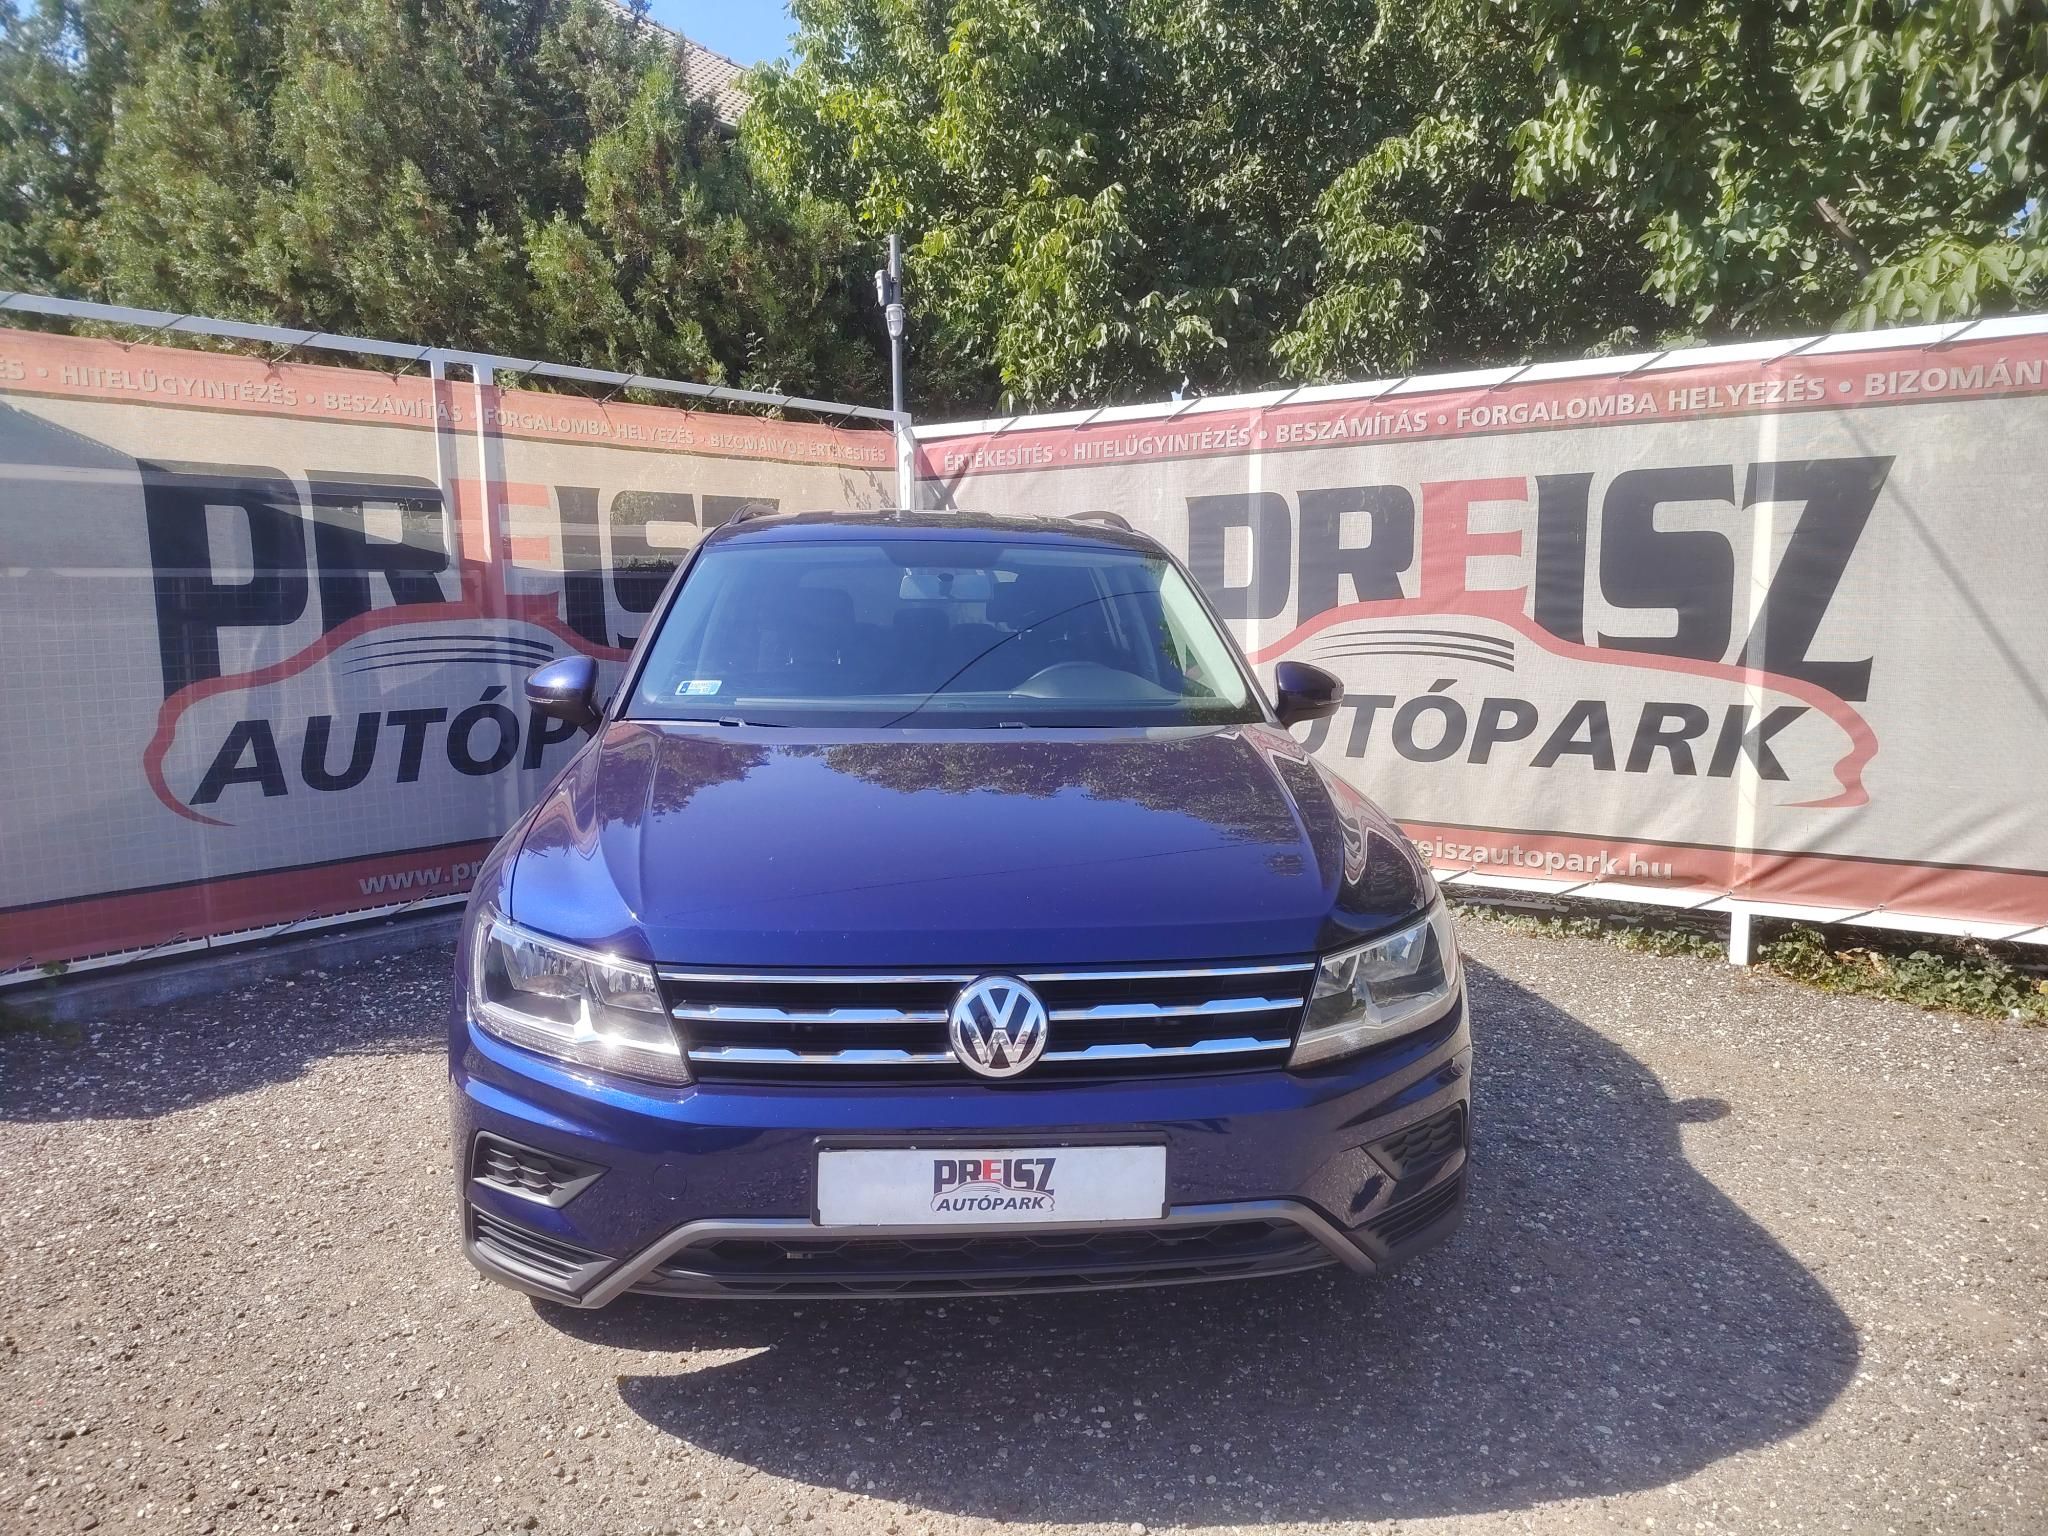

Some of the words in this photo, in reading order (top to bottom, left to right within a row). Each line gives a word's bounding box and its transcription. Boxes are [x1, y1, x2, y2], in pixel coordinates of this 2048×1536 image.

[62, 364, 299, 407] HITELÜGYINTÉZÉS
[323, 391, 464, 422] BESZÁMÍTÁS
[484, 408, 613, 437] FORGALOMBA
[616, 420, 696, 445] HELYEZÉS
[944, 445, 1053, 472] ÉRTÉKESÍTÉS
[1074, 425, 1252, 461] HITELÜGYINTÉZÉS
[1275, 408, 1428, 444] BESZÁMÍTÁS
[1456, 390, 1659, 428] FORGALOMBA
[1667, 373, 1826, 412] HELYEZÉS
[1864, 357, 2048, 397] BIZOMÁN
[1186, 455, 1896, 702] PREISZ
[934, 1158, 1057, 1195] PREISZ
[936, 1195, 1046, 1212] AUTÓPARK
